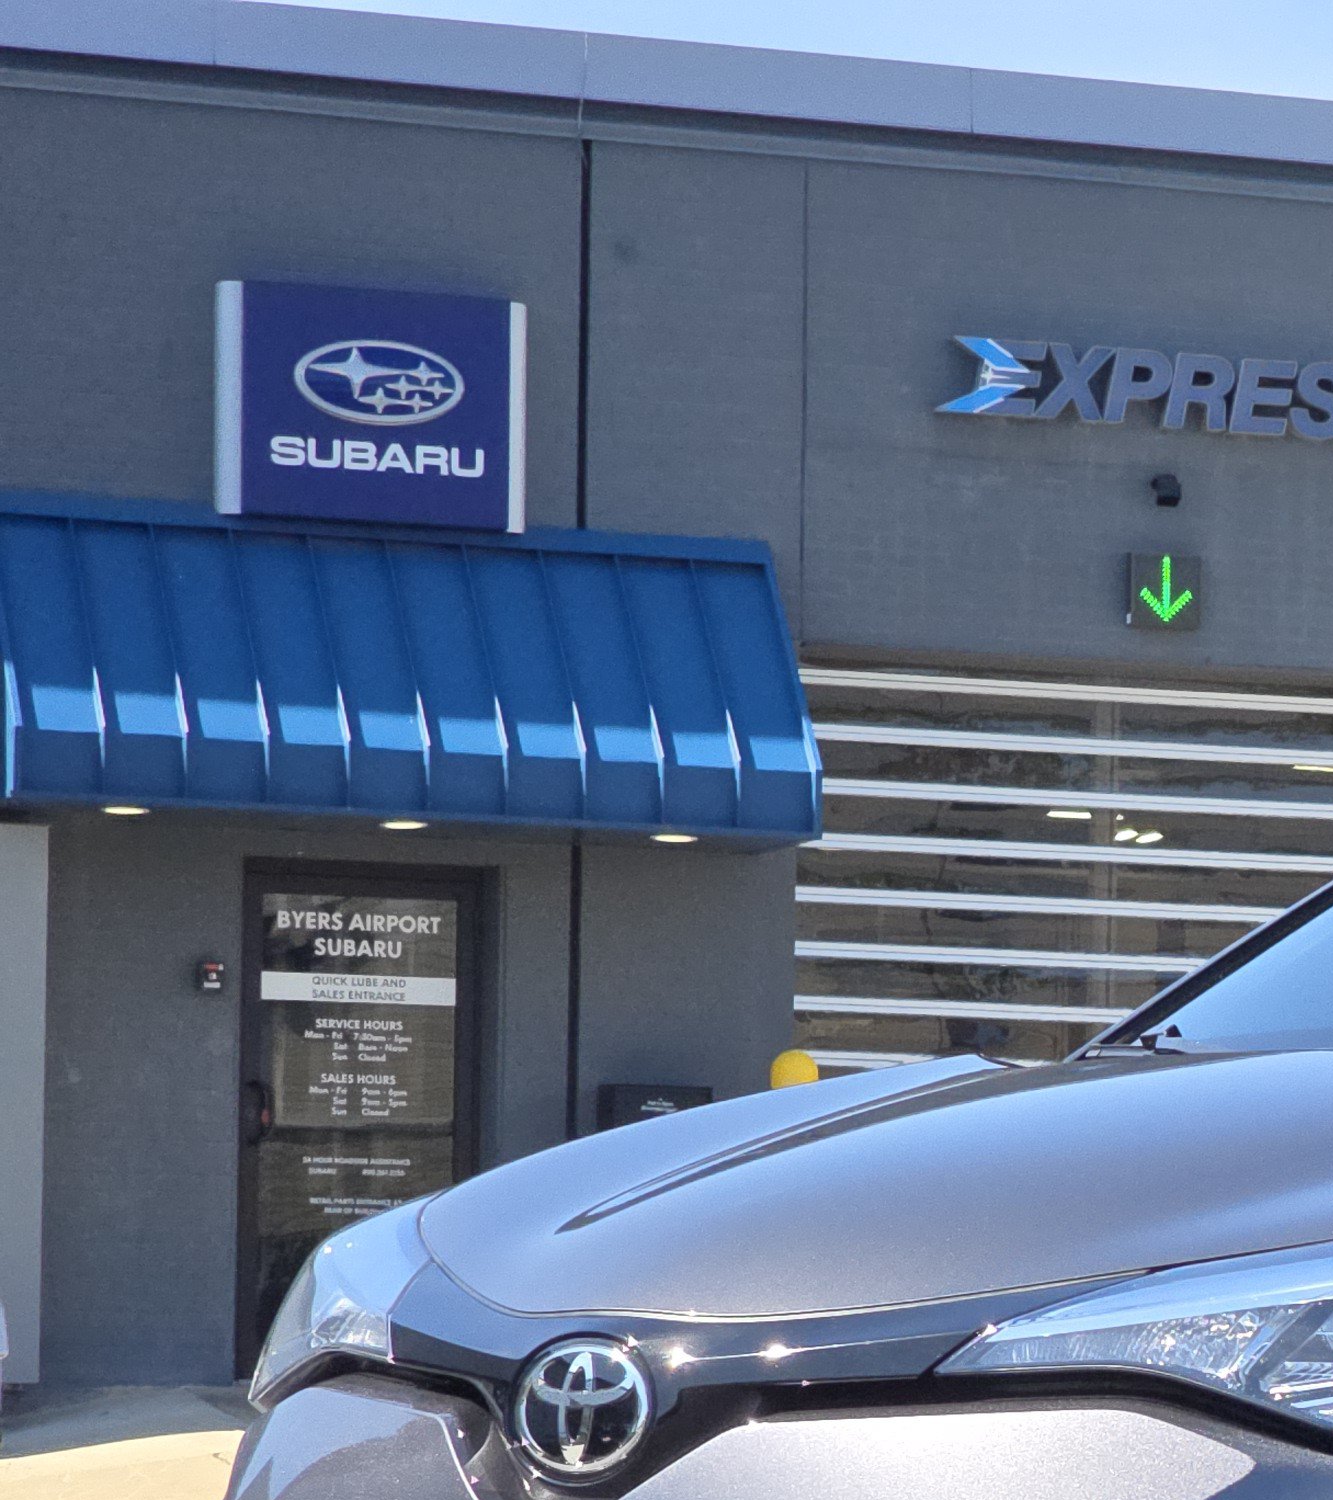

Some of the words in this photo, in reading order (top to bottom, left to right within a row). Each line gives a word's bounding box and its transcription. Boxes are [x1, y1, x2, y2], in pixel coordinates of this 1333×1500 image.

[269, 435, 485, 478] SUBARU
[277, 910, 343, 931] BYERS
[349, 913, 441, 934] AIRPORT
[313, 937, 402, 959] SUBARU
[312, 976, 347, 986] QUICK
[351, 977, 379, 987] LUBE
[381, 978, 406, 988] AND
[312, 989, 345, 999] SALES
[348, 990, 406, 1001] ENTRANCE
[315, 1018, 360, 1029] SERVICE
[363, 1020, 403, 1031] HOURS
[321, 1073, 354, 1084] SALES
[357, 1074, 397, 1085] HOURS
